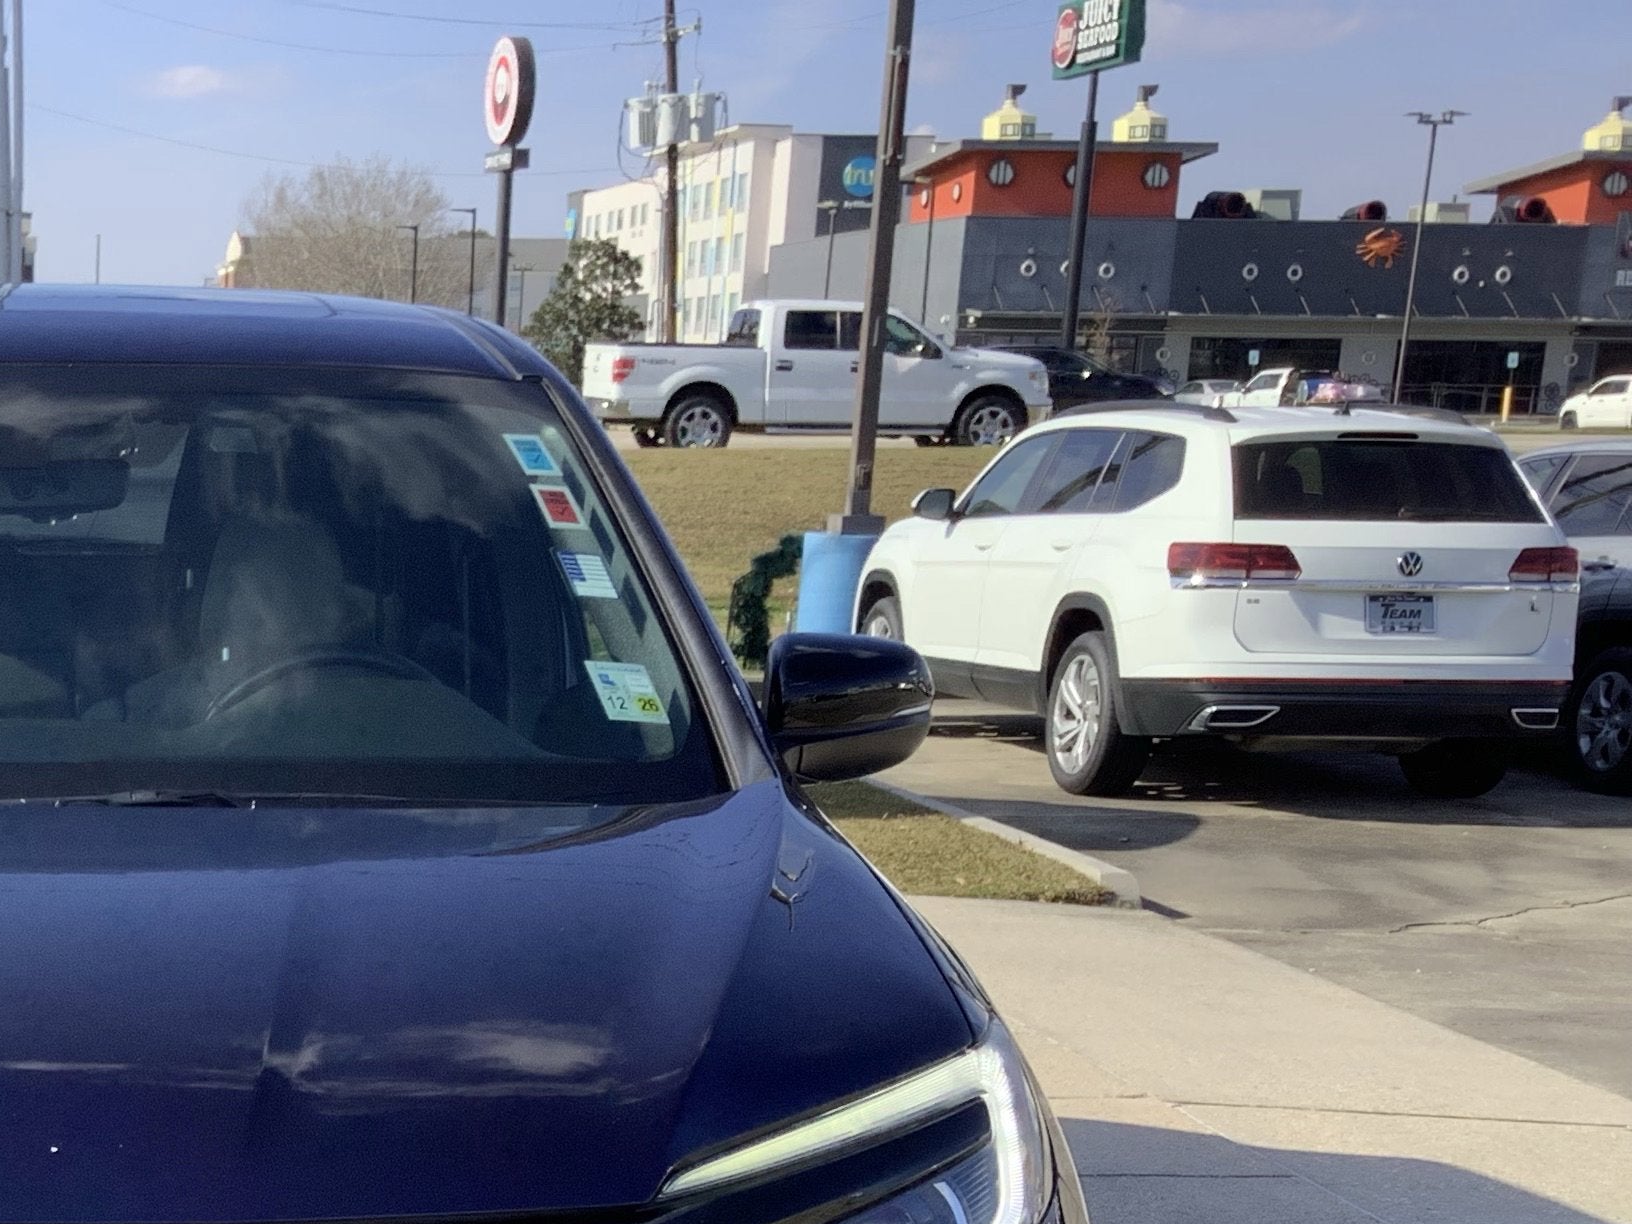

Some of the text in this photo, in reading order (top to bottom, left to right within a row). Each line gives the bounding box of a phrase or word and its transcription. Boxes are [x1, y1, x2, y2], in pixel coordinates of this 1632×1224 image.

[1077, 22, 1119, 49] SEAFOOD
[1381, 603, 1422, 619] TEAM
[608, 695, 659, 712] 12 26
